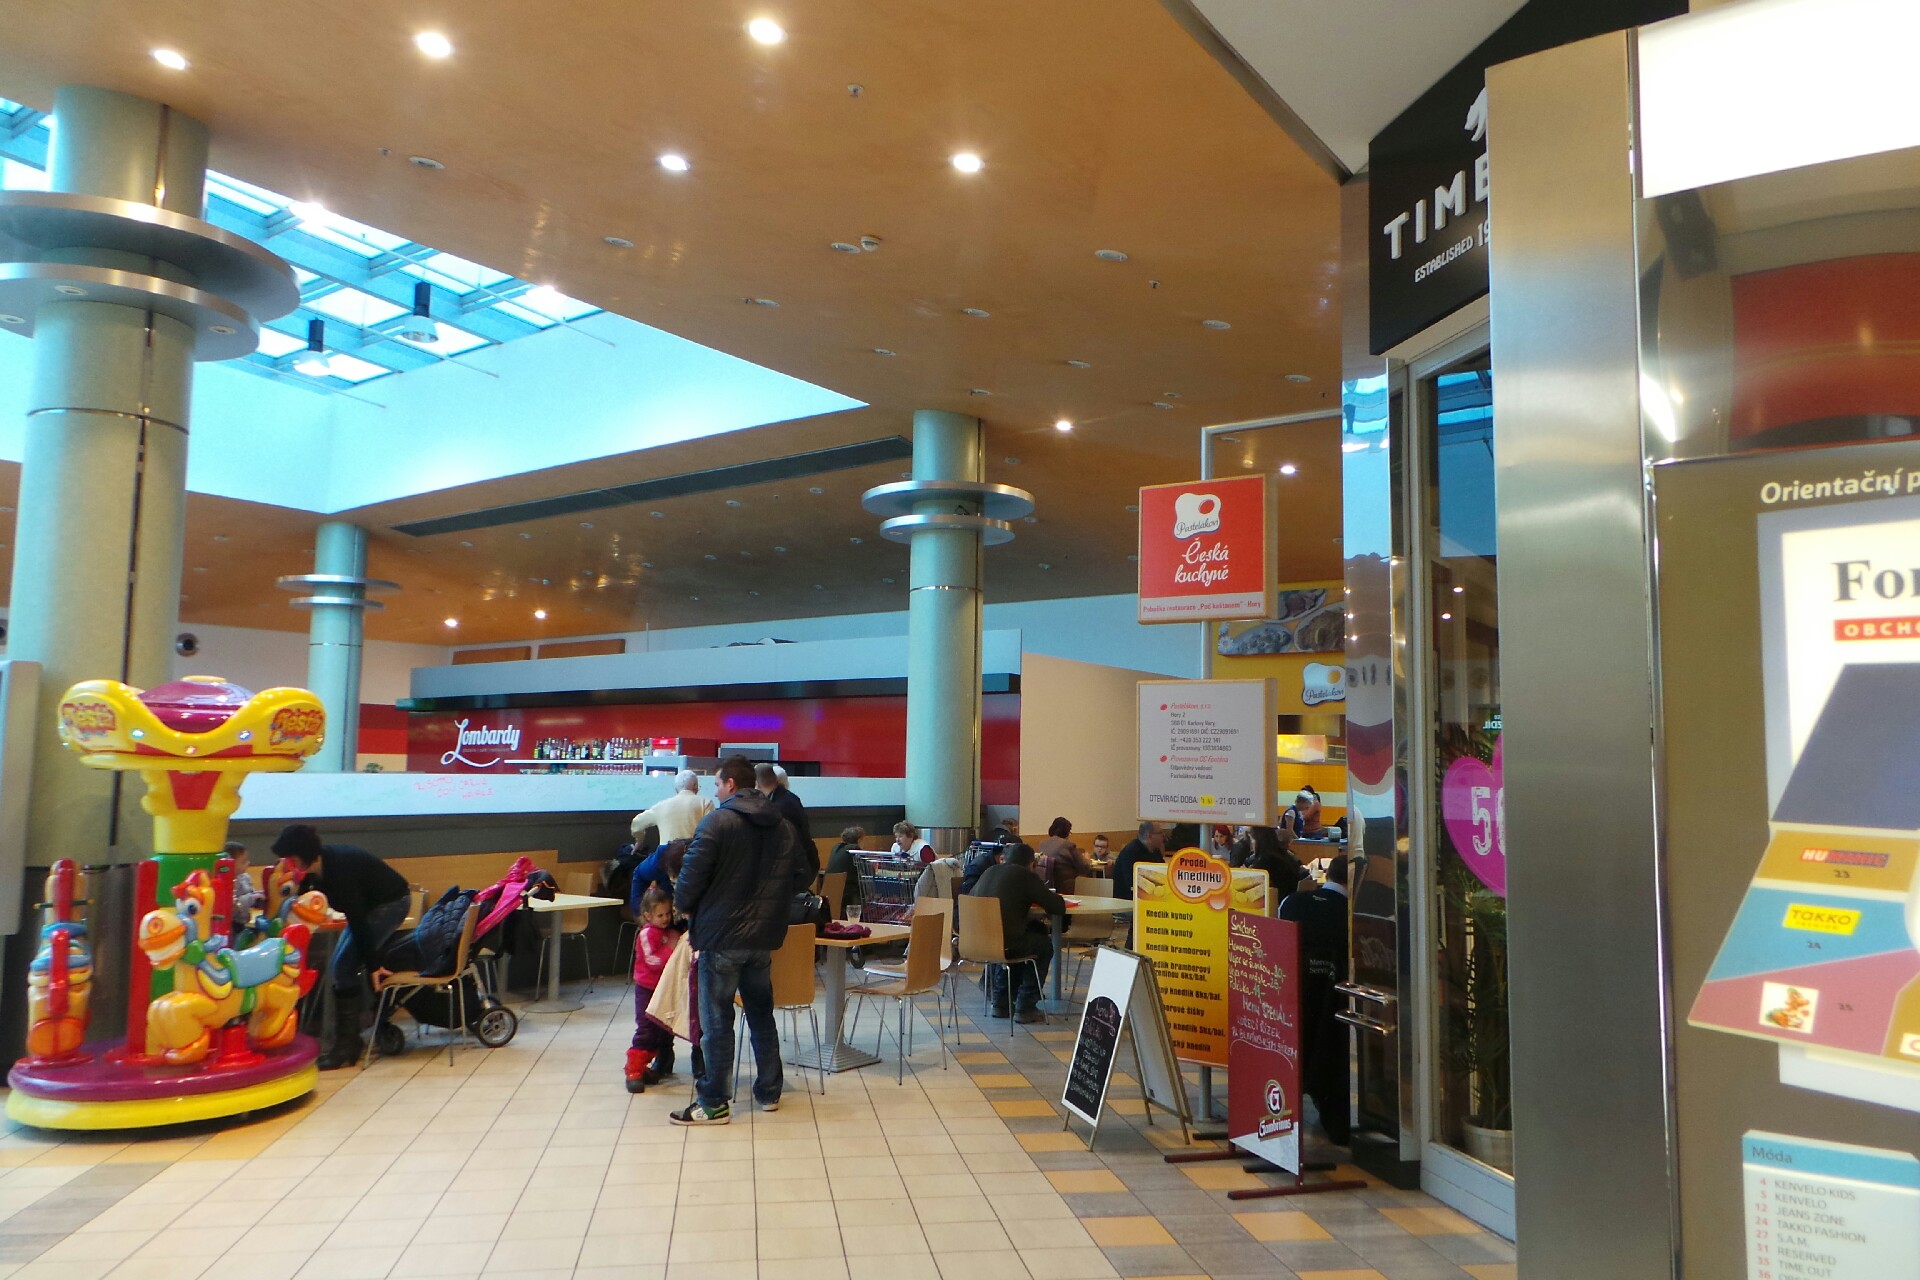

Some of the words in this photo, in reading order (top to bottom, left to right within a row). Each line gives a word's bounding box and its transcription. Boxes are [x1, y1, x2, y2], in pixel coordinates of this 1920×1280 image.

[1415, 235, 1474, 283] ESTABLISHED
[1760, 468, 1904, 504] Orientační
[1181, 537, 1229, 564] Česká
[1174, 562, 1229, 587] kuchyně
[1247, 600, 1262, 609] Hory
[1170, 711, 1181, 719] Hory
[1187, 719, 1204, 727] Karlovy
[440, 718, 521, 768] Lombardy
[1180, 857, 1207, 868] Prodej
[1187, 884, 1202, 894] zde
[1170, 911, 1194, 921] kynutý
[1170, 928, 1194, 938] kynutý
[1170, 944, 1211, 958] bramborový
[1170, 962, 1211, 974] bramborový
[1751, 1146, 1793, 1165] Móda
[1759, 1178, 1767, 1186] 4
[1774, 1179, 1827, 1197] KENVELO
[1828, 1187, 1857, 1201] KIDS
[1775, 1193, 1828, 1210] KENVELO
[1755, 1202, 1768, 1212] 12
[1776, 1205, 1811, 1221] JEANS
[1813, 1212, 1847, 1226] ZONE
[1755, 1216, 1769, 1226] 24
[1776, 1219, 1813, 1234] TAKKO
[1814, 1226, 1867, 1244] FASHION
[1755, 1229, 1769, 1239] 27
[1777, 1246, 1837, 1266] RESERVED
[1778, 1259, 1804, 1273] TIME
[1807, 1266, 1832, 1277] OUT
